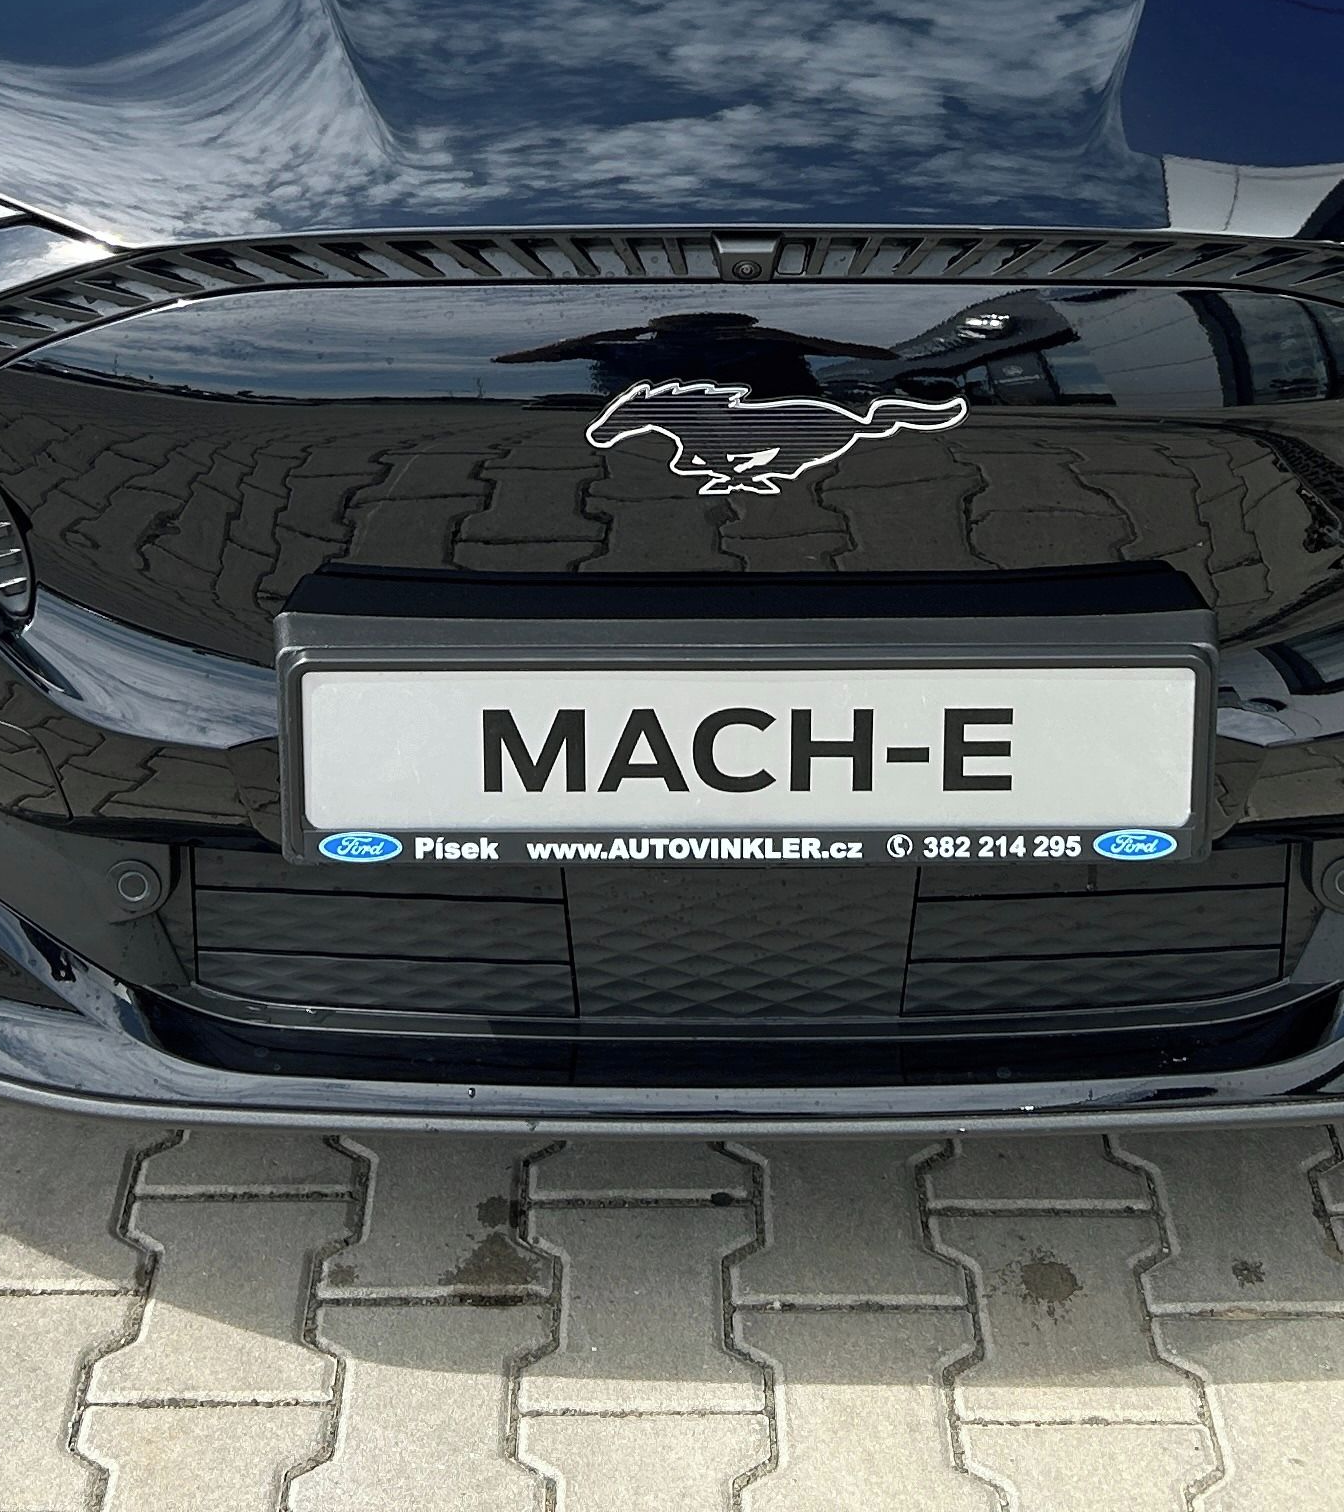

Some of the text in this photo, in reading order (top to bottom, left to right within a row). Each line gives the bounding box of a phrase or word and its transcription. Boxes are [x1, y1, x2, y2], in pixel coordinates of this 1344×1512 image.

[481, 707, 1016, 794] MACH-E
[415, 836, 500, 860] Písek
[527, 836, 863, 861] www.AUTOVINKLER.cz
[923, 835, 971, 859] 382
[978, 835, 1026, 859] 214
[1033, 834, 1082, 858] 295
